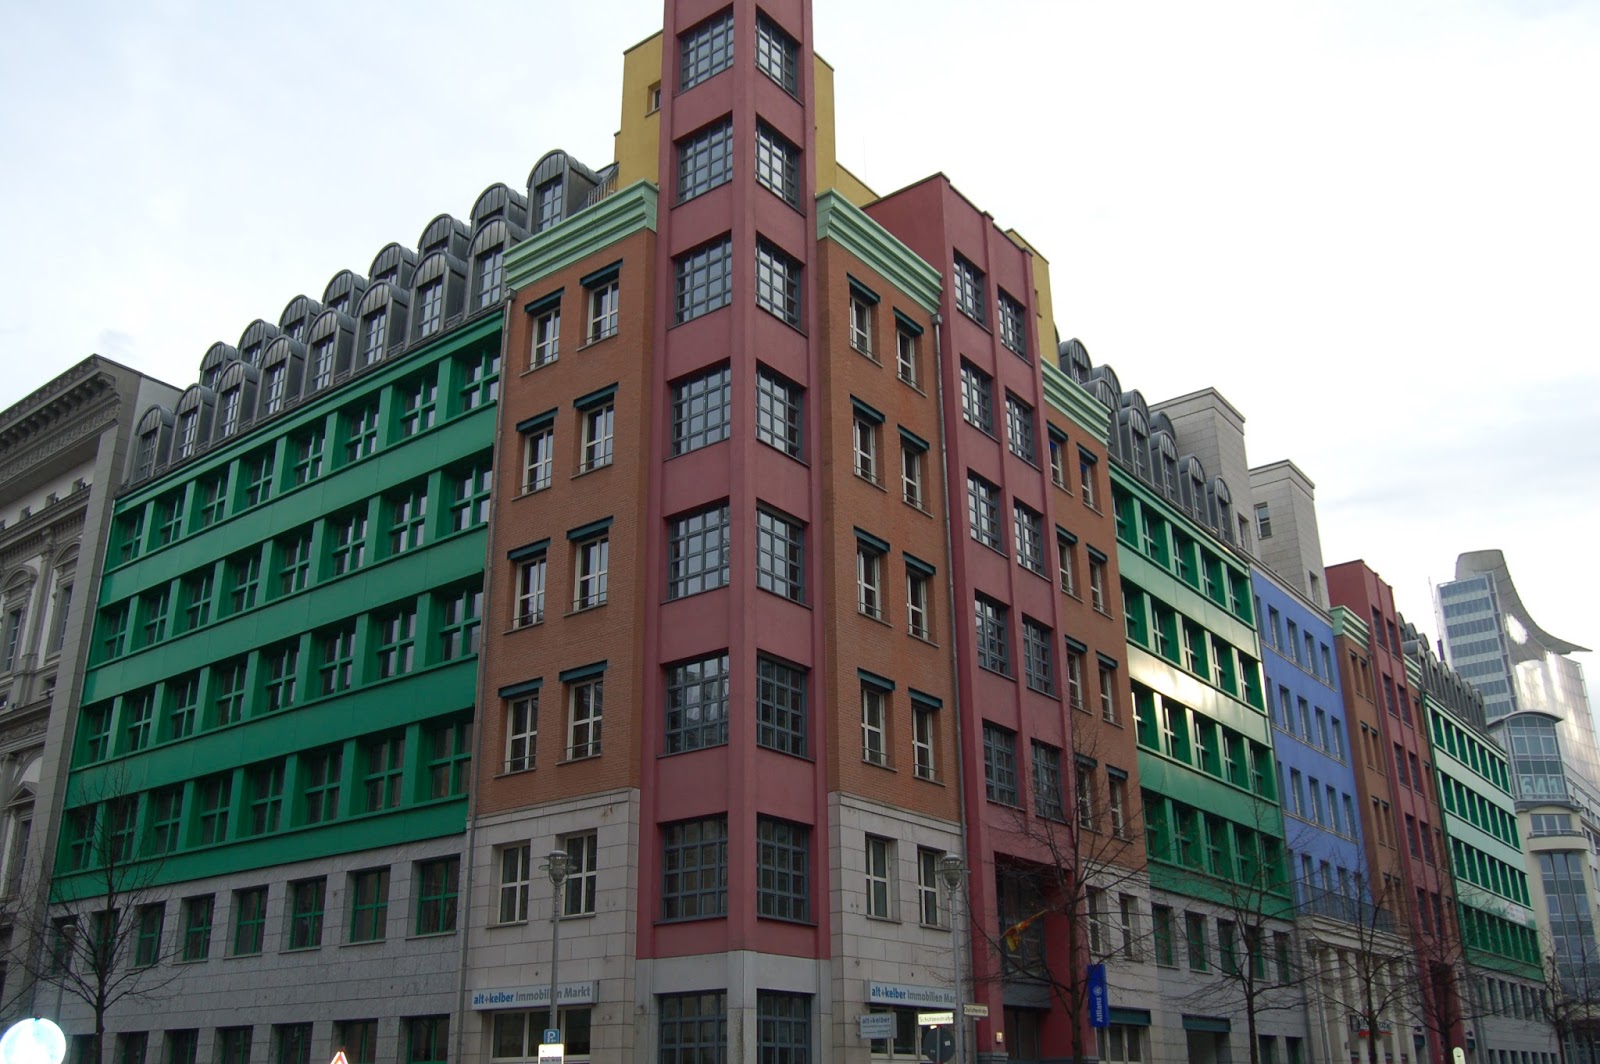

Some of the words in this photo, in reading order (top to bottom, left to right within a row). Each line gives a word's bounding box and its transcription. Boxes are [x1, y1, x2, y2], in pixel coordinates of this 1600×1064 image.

[474, 992, 514, 1005] alt+kelber
[516, 989, 562, 1002] Immobilin
[564, 986, 591, 998] Markt
[872, 986, 906, 999] alt+kelber
[907, 989, 943, 1002] Immobilien
[1096, 997, 1104, 1022] Allianz
